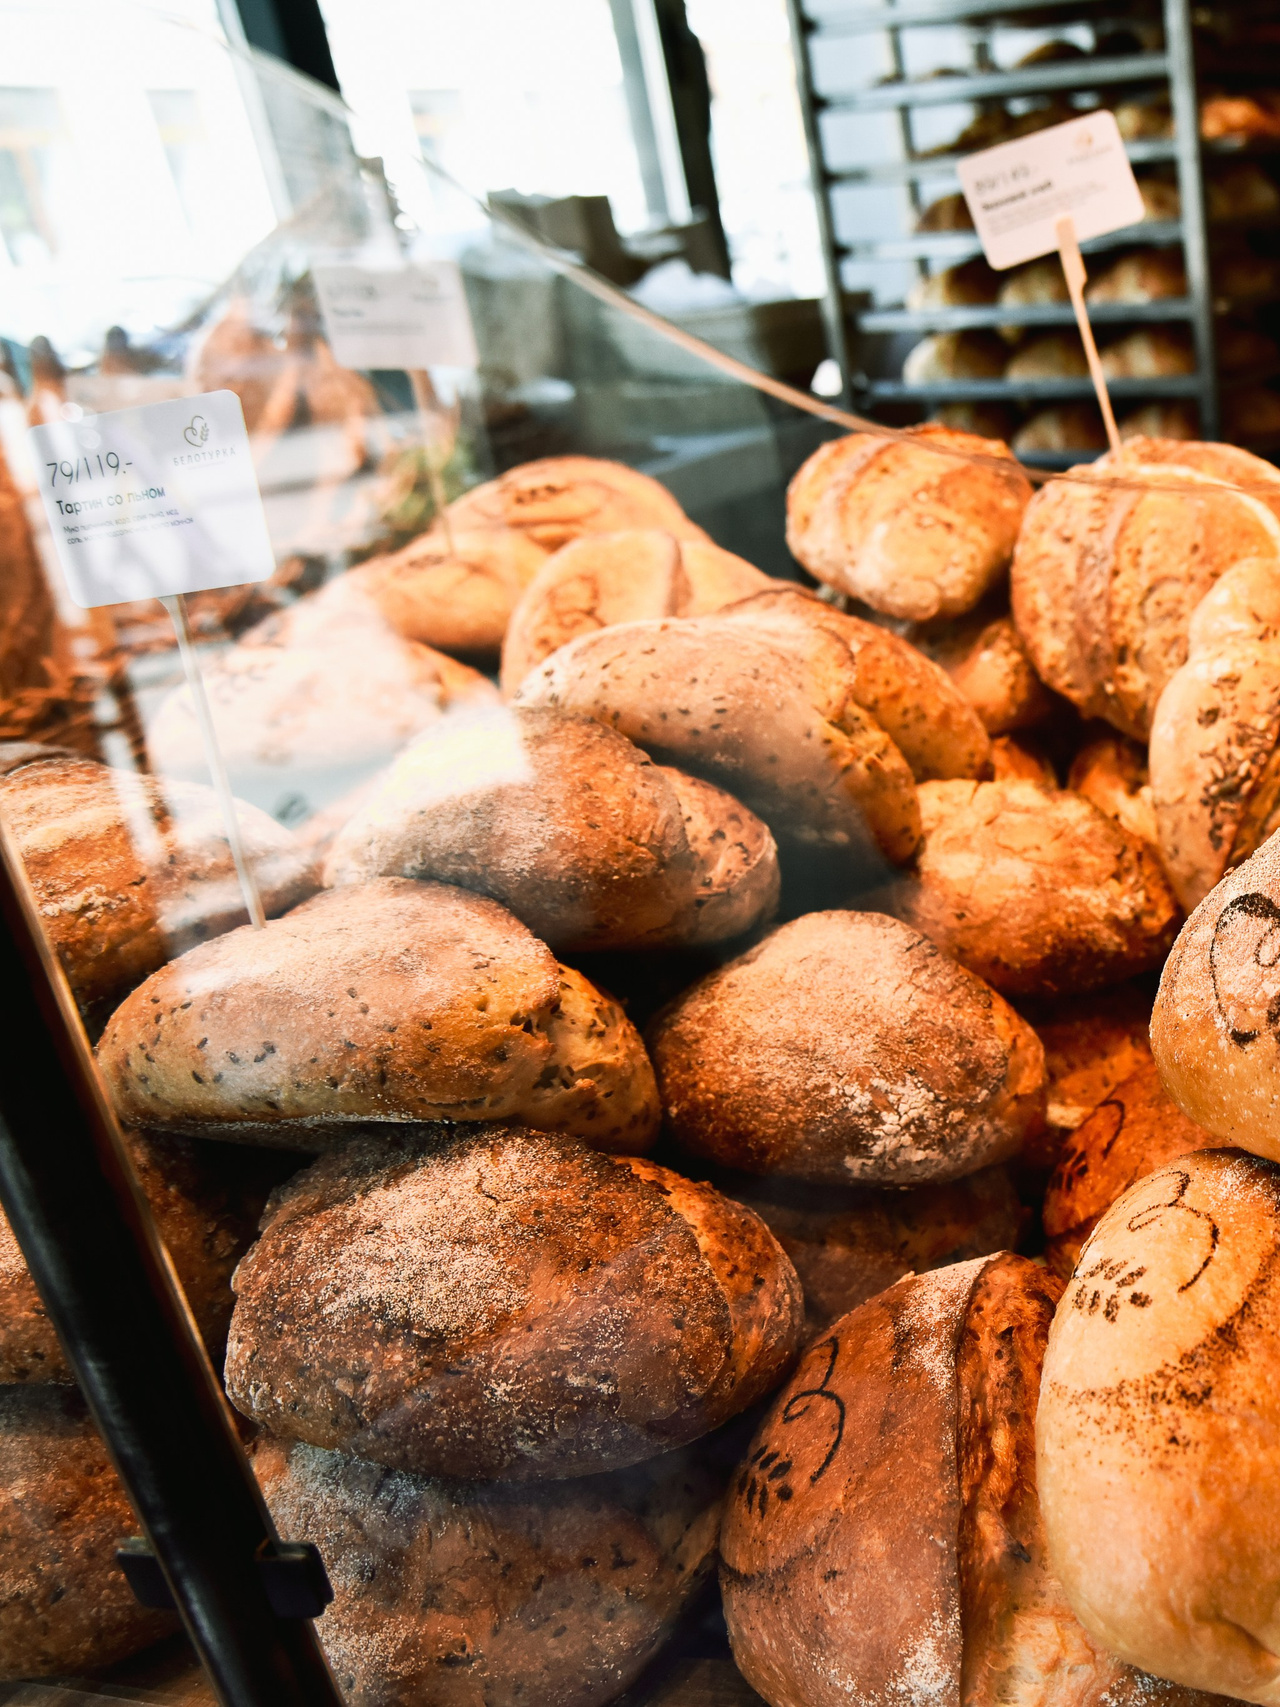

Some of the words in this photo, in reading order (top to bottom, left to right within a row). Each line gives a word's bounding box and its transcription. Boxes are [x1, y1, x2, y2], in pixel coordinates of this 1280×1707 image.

[45, 450, 134, 489] 79/119.-
[172, 446, 238, 468] БЕЛОТУРКА
[55, 498, 104, 516] Тартин
[106, 493, 124, 507] со
[126, 486, 167, 504] льном
